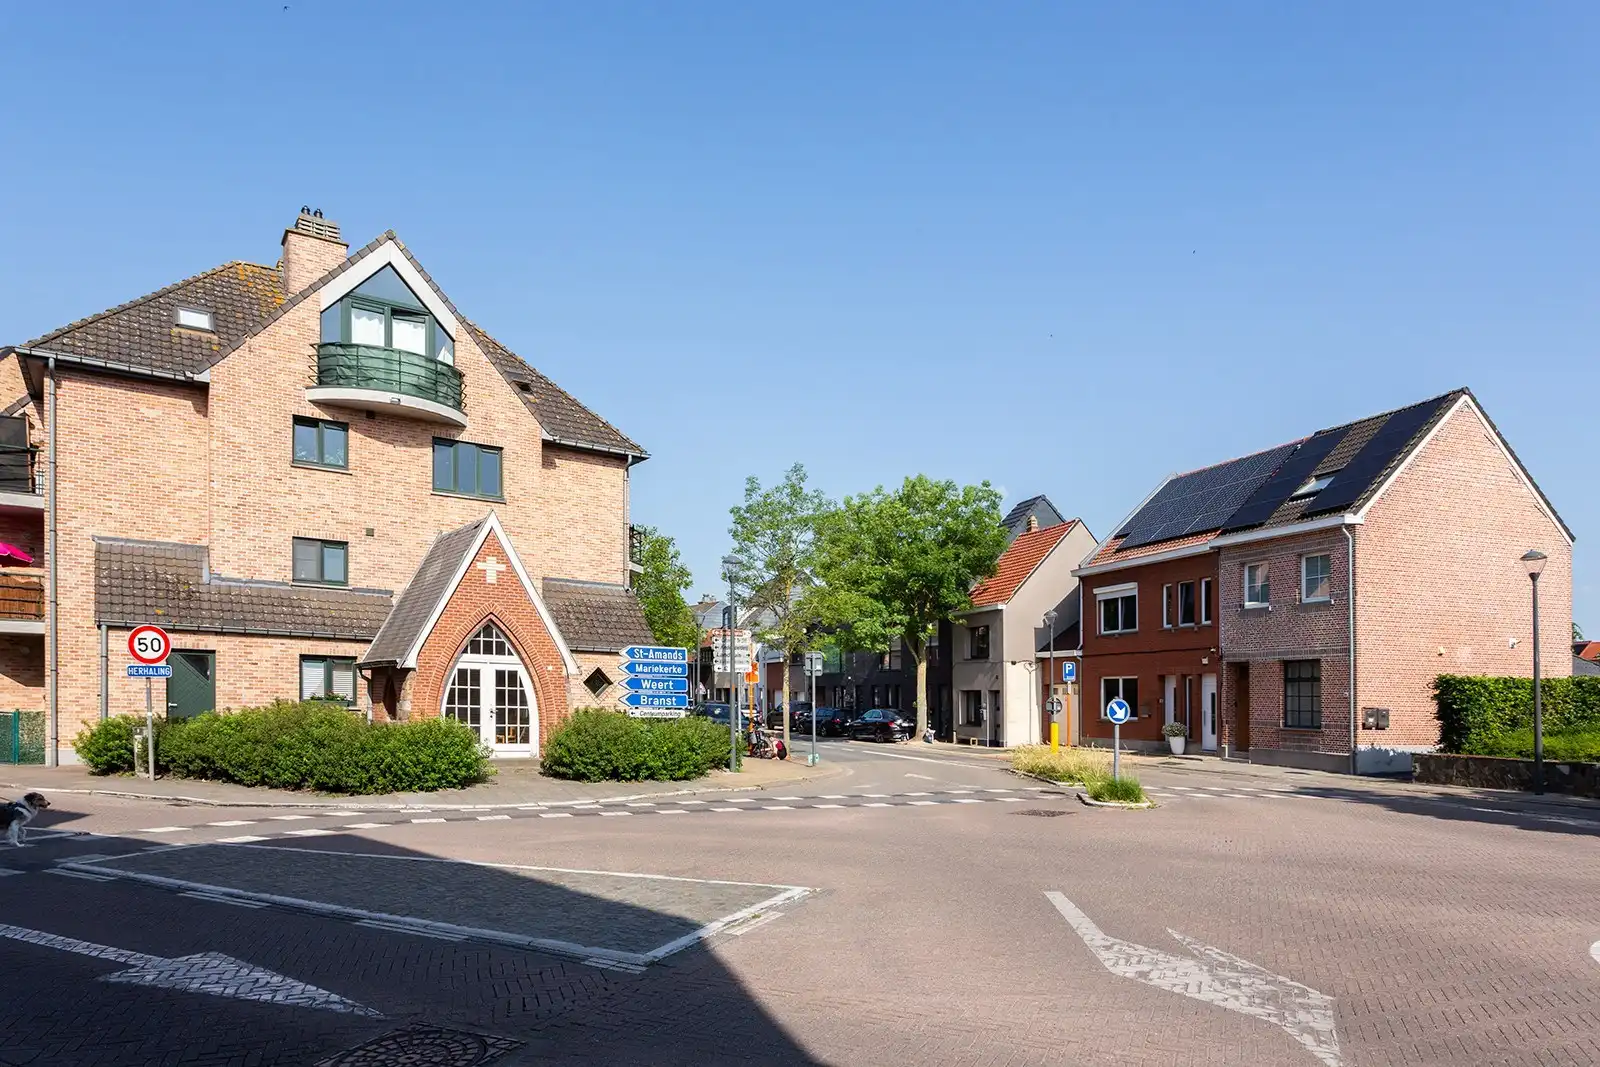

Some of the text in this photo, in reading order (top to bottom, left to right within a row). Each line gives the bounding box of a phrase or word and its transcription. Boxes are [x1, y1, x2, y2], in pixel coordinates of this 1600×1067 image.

[137, 637, 161, 653] 50
[634, 648, 683, 660] St-Amands
[128, 667, 171, 676] HERHALING
[635, 664, 682, 674] Mariekerke
[1065, 663, 1073, 674] P
[641, 679, 674, 689] Weert
[640, 695, 677, 706] Branst
